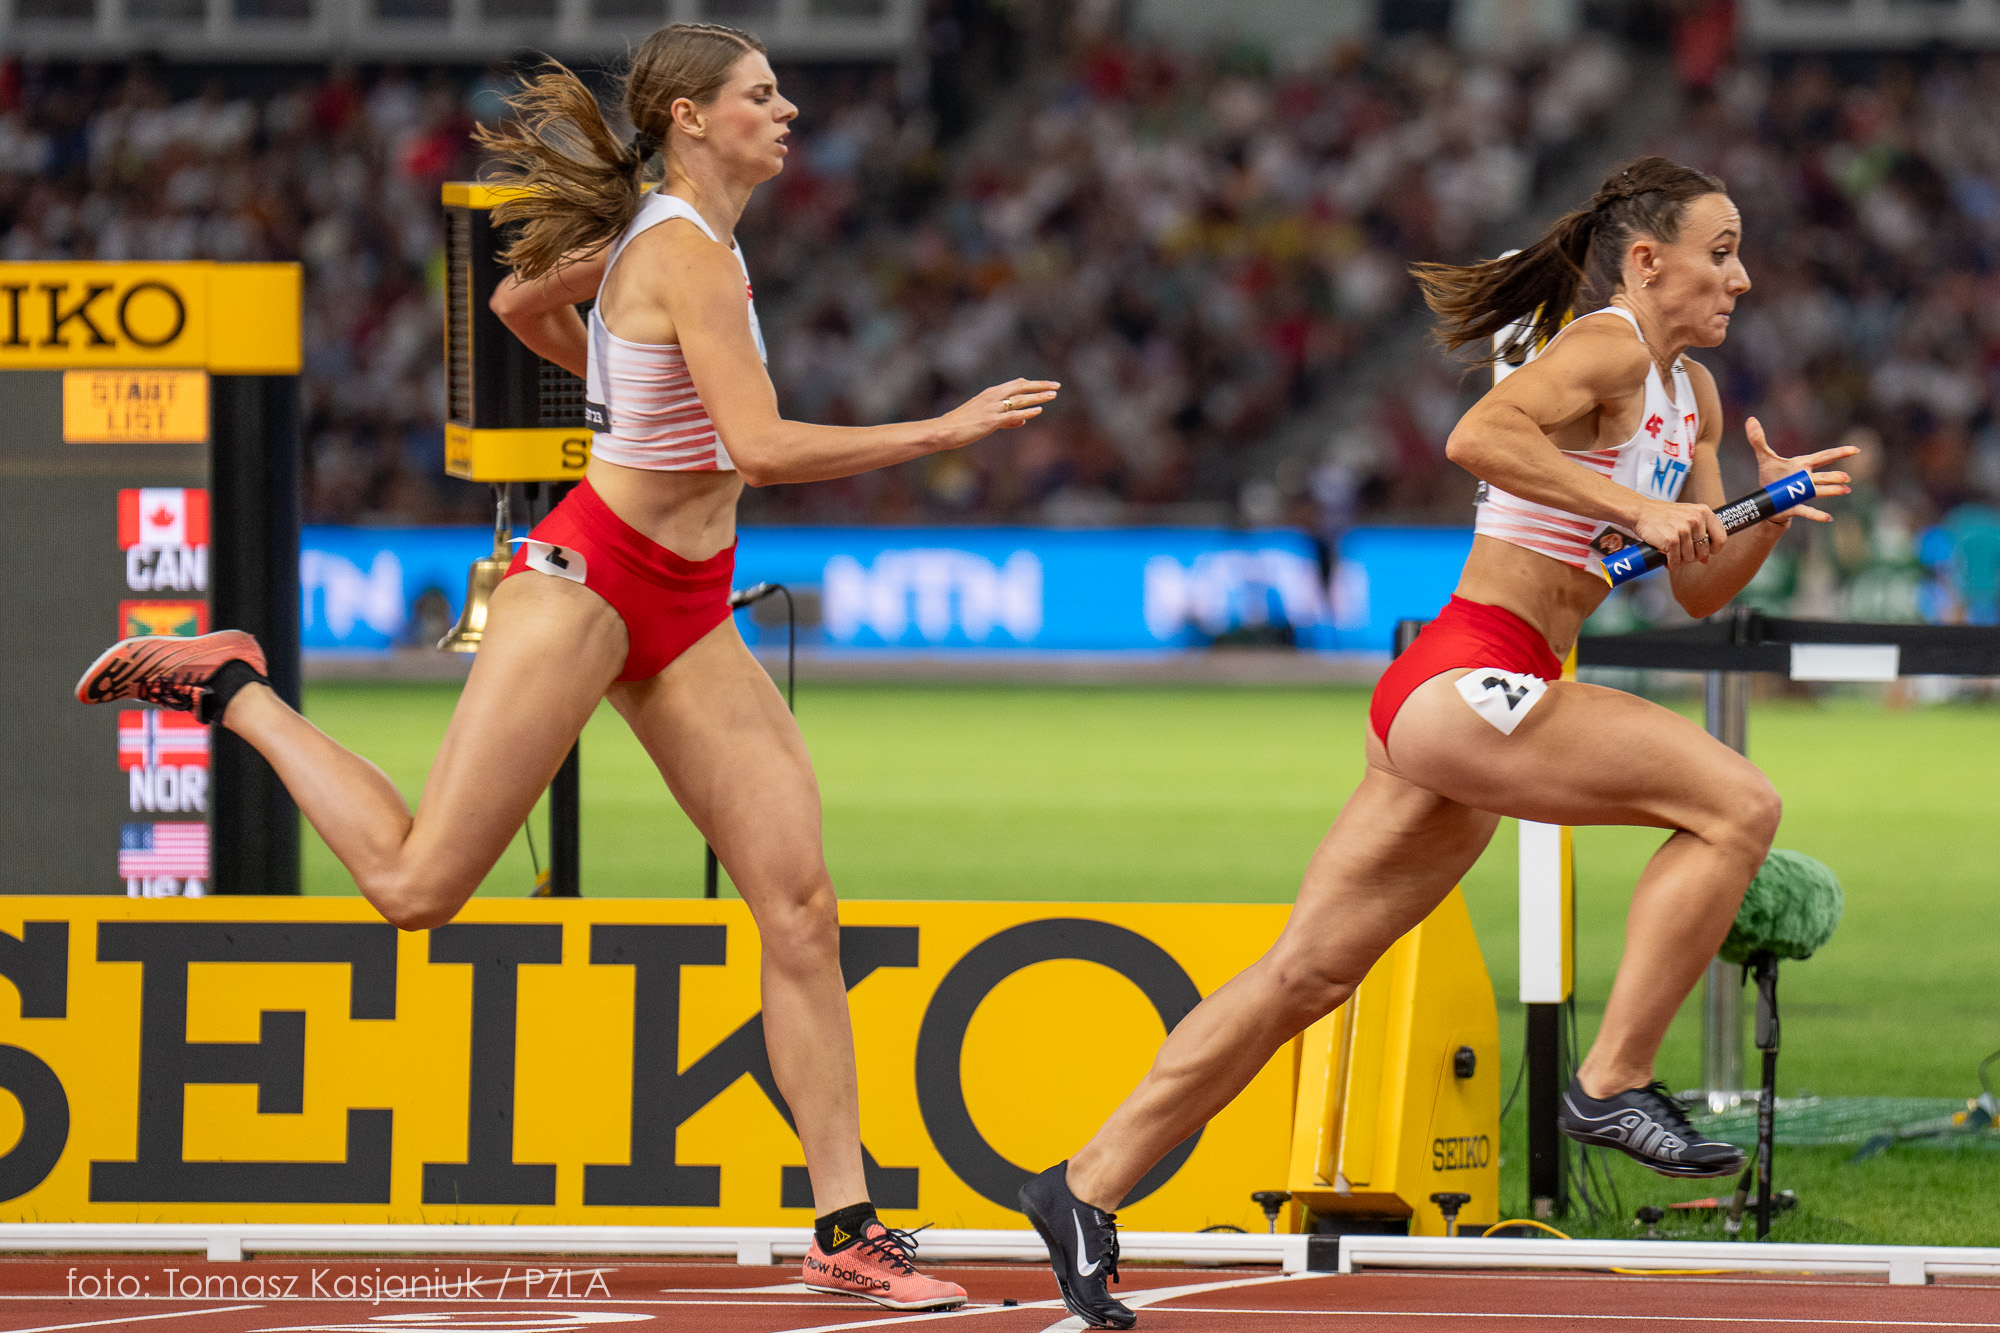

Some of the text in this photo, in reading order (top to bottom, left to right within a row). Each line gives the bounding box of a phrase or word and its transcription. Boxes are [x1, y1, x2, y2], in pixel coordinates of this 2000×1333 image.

[561, 437, 593, 471] S
[1650, 455, 1692, 500] NT
[1786, 480, 1806, 500] 2
[1722, 498, 1756, 518] ATHLETICS
[127, 543, 208, 591] CAN
[1613, 557, 1633, 576] 2
[1481, 676, 1530, 711] 2
[129, 764, 210, 813] NOR
[1432, 1134, 1490, 1172] SEIKO
[804, 1256, 891, 1292] new balance
